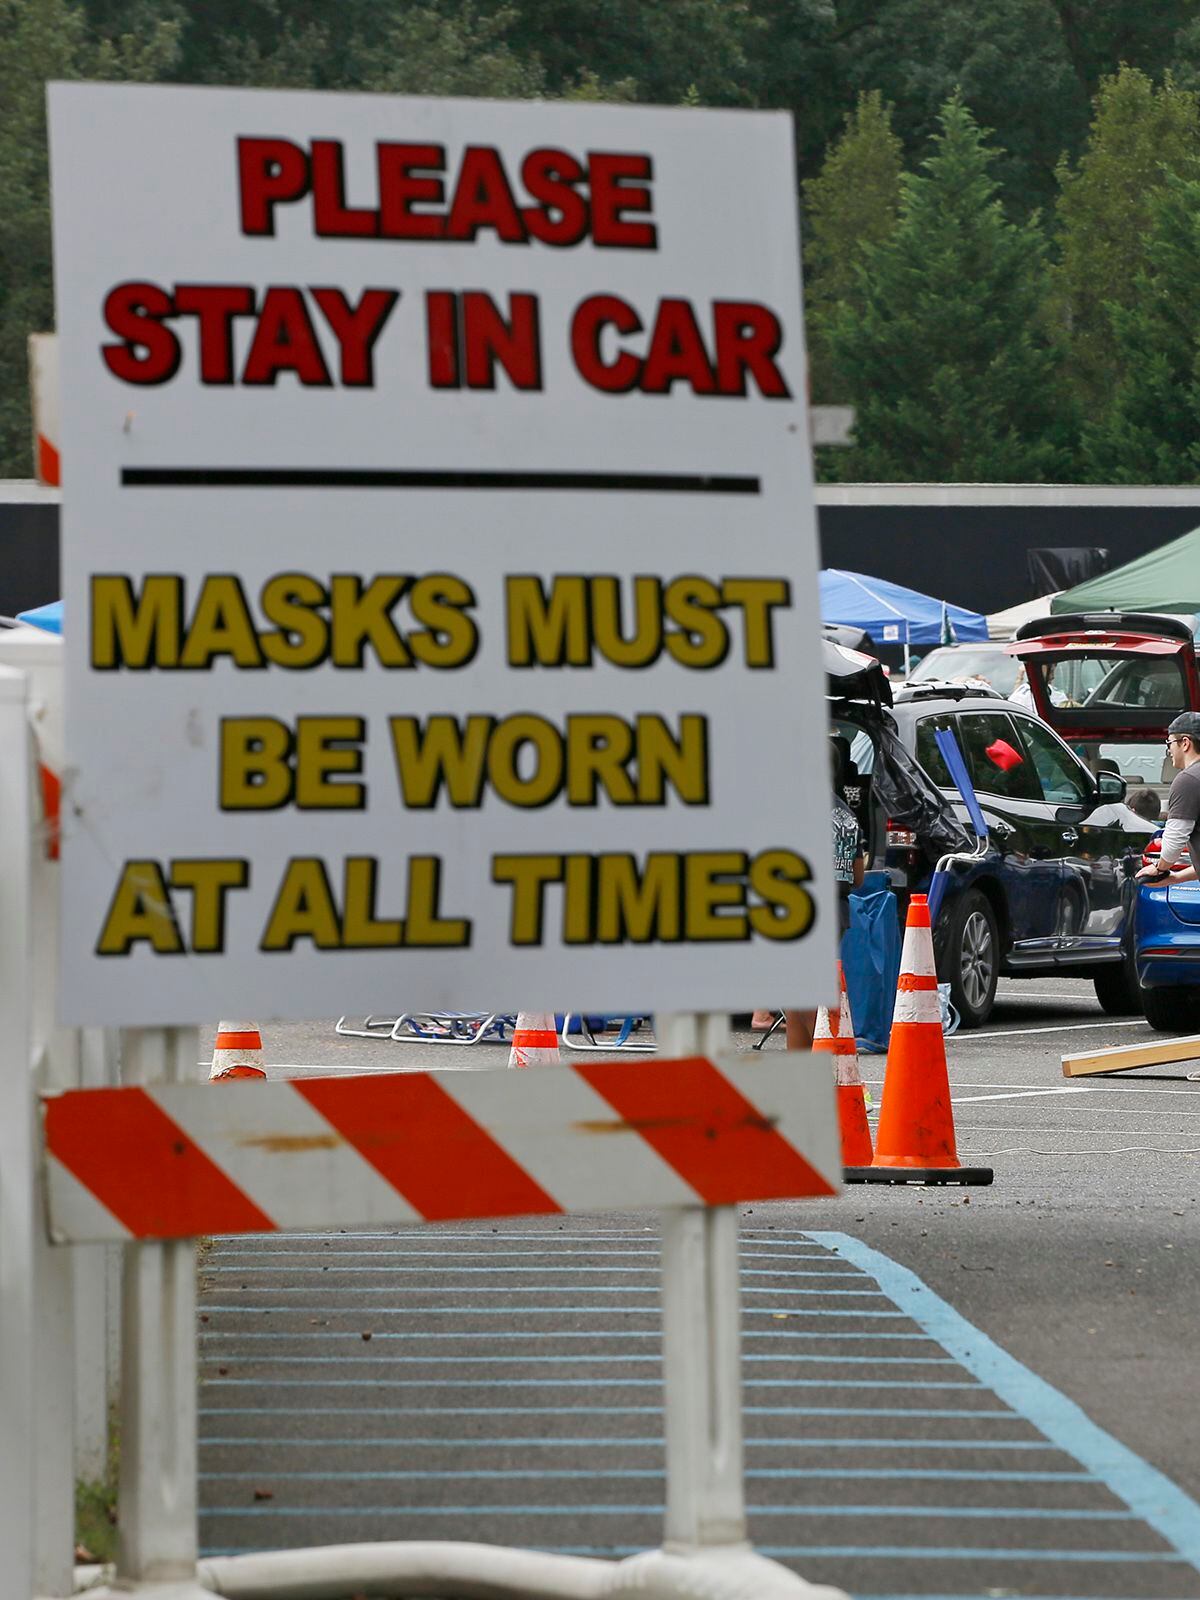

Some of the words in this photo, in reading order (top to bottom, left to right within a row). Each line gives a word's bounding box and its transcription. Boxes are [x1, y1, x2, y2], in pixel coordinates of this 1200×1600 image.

[236, 136, 659, 250] PLEASE
[101, 281, 399, 388] STAY
[427, 290, 543, 391] IN
[571, 294, 792, 399] CAR
[90, 572, 479, 670] MASKS
[506, 573, 791, 669] MUST
[219, 715, 366, 811] BE
[391, 711, 711, 808] WORN
[96, 857, 249, 956] AT
[260, 855, 471, 951] ALL
[492, 848, 817, 946] TIMES
